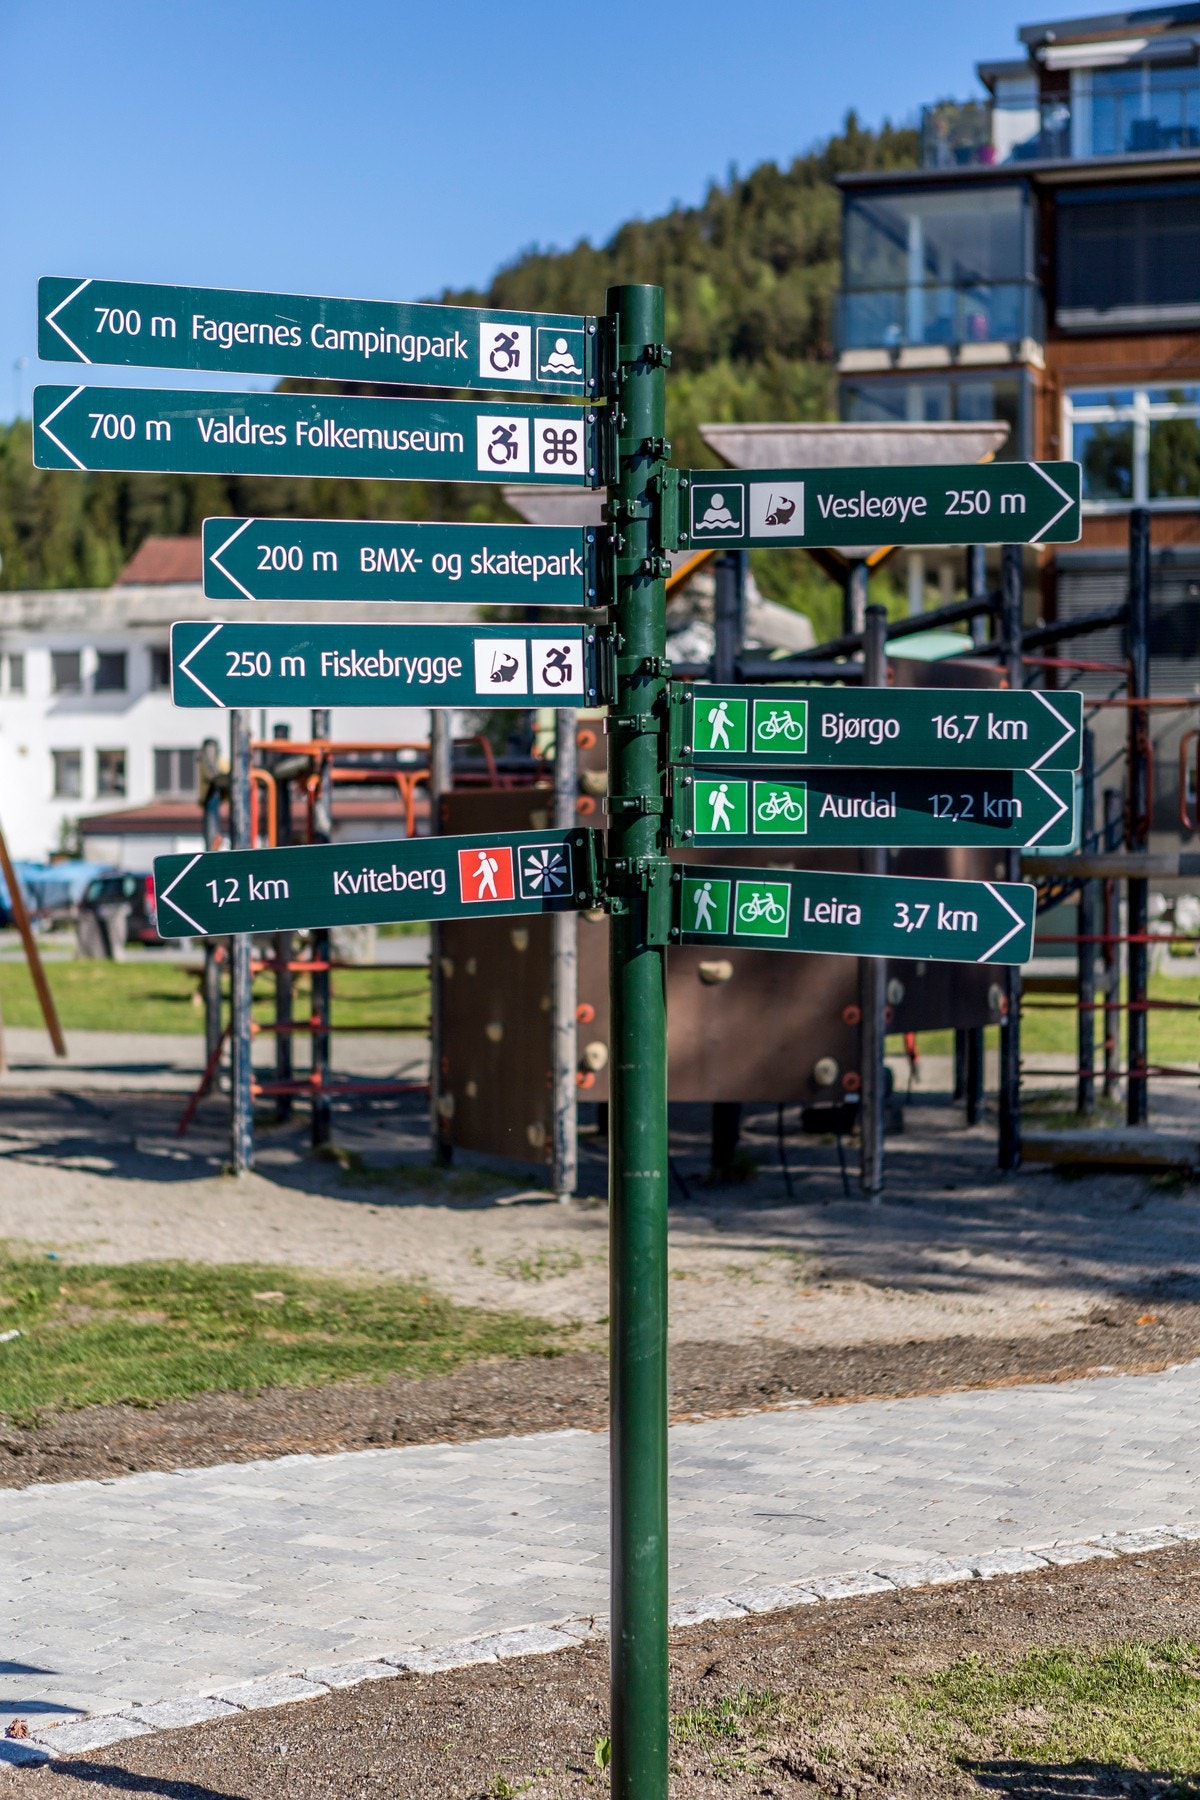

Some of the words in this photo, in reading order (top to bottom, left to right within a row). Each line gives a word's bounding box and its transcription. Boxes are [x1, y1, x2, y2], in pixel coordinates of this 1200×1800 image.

[95, 308, 141, 335] 700
[152, 317, 176, 337] m
[193, 315, 301, 348] Fagernes
[311, 325, 468, 362] Campingpark
[89, 414, 135, 439] 700
[146, 421, 170, 441] m
[197, 415, 286, 445] Valdres
[296, 419, 463, 452] Folkemuseum
[817, 490, 927, 522] Vesleøye
[945, 490, 990, 515] 250
[1001, 494, 1025, 513] m
[257, 545, 303, 570] 200
[313, 551, 337, 571] m
[361, 547, 422, 572] BMX-
[432, 554, 461, 580] og
[470, 547, 584, 581] skatepark
[226, 652, 271, 676] 250
[281, 657, 305, 676] m
[321, 649, 462, 683] Fiskebrygge
[822, 713, 900, 745] Bjørgo
[932, 715, 979, 743] 16,7
[988, 713, 1027, 739] km
[819, 791, 897, 819] Aurdal
[928, 795, 974, 822] 12,2
[983, 791, 1023, 819] km
[206, 878, 240, 906] 1,2
[249, 874, 289, 900] km
[334, 865, 446, 895] Kviteberg
[804, 898, 861, 925] Leira
[894, 903, 930, 932] 3,7
[938, 902, 977, 931] km
